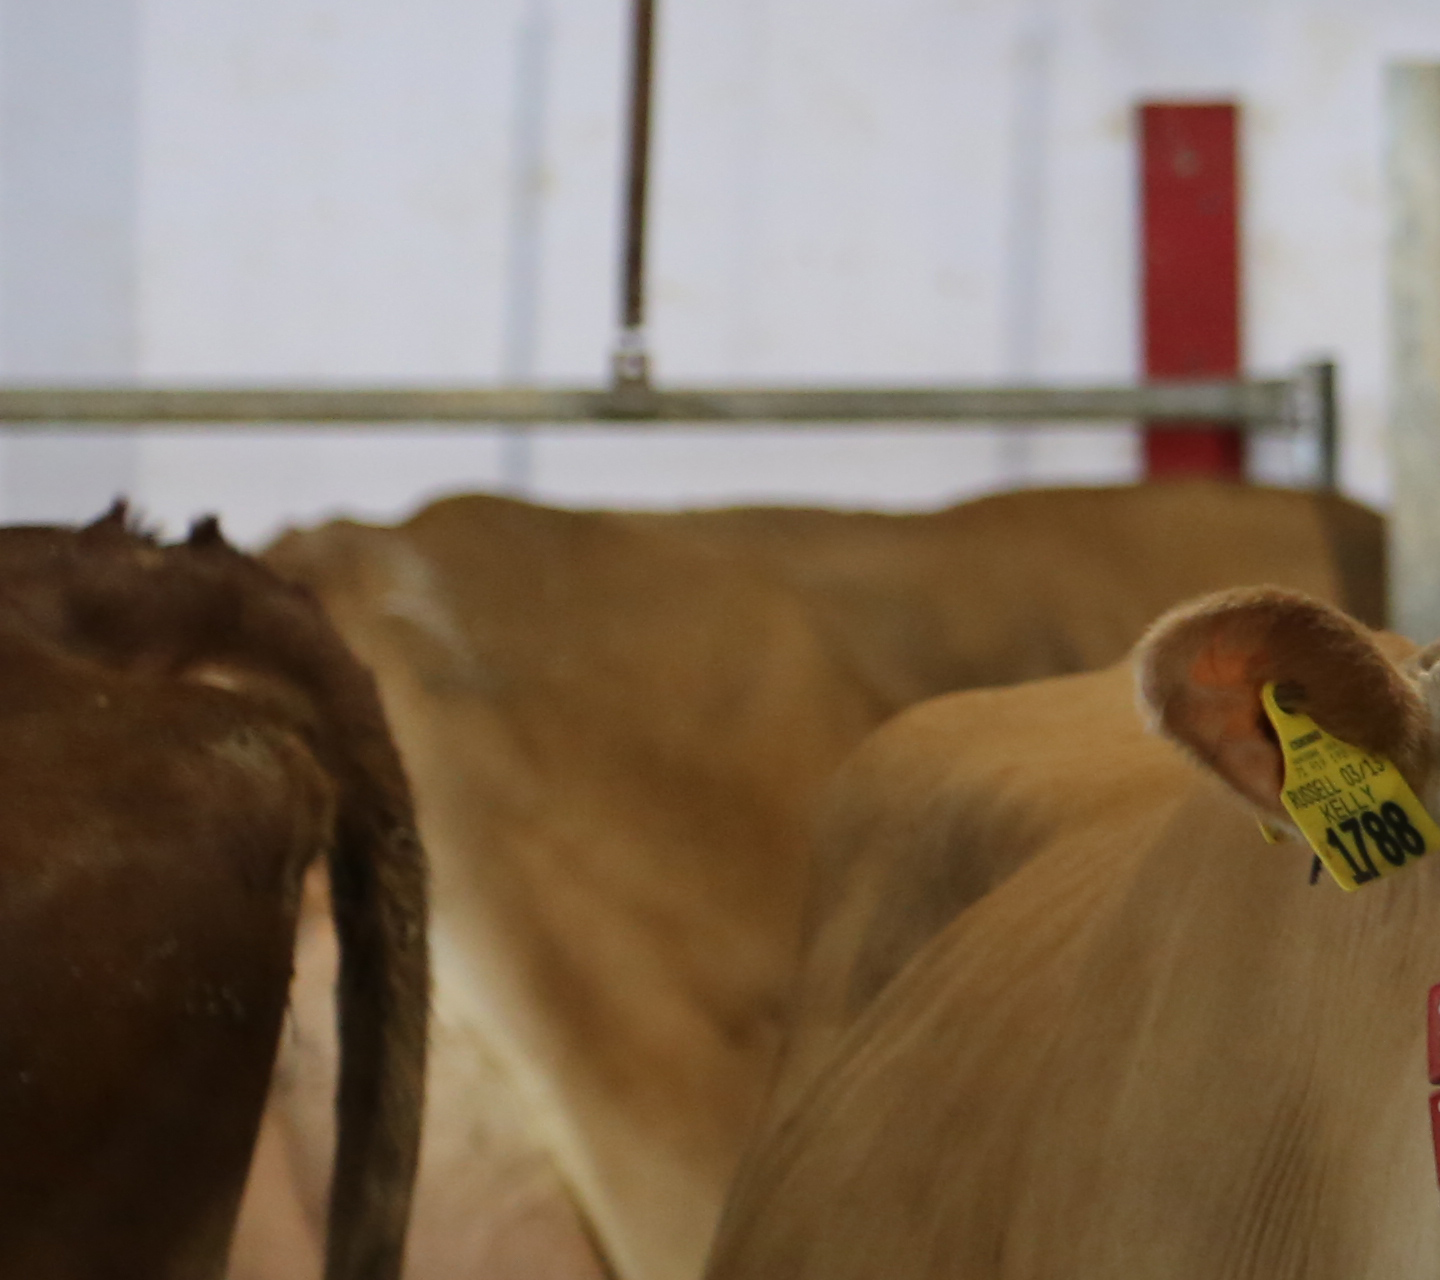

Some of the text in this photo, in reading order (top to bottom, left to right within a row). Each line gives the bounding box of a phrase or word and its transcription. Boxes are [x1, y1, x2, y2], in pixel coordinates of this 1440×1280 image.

[1286, 776, 1341, 809] RUSSELL
[1319, 784, 1376, 823] KELLY
[1326, 801, 1426, 885] 1788
